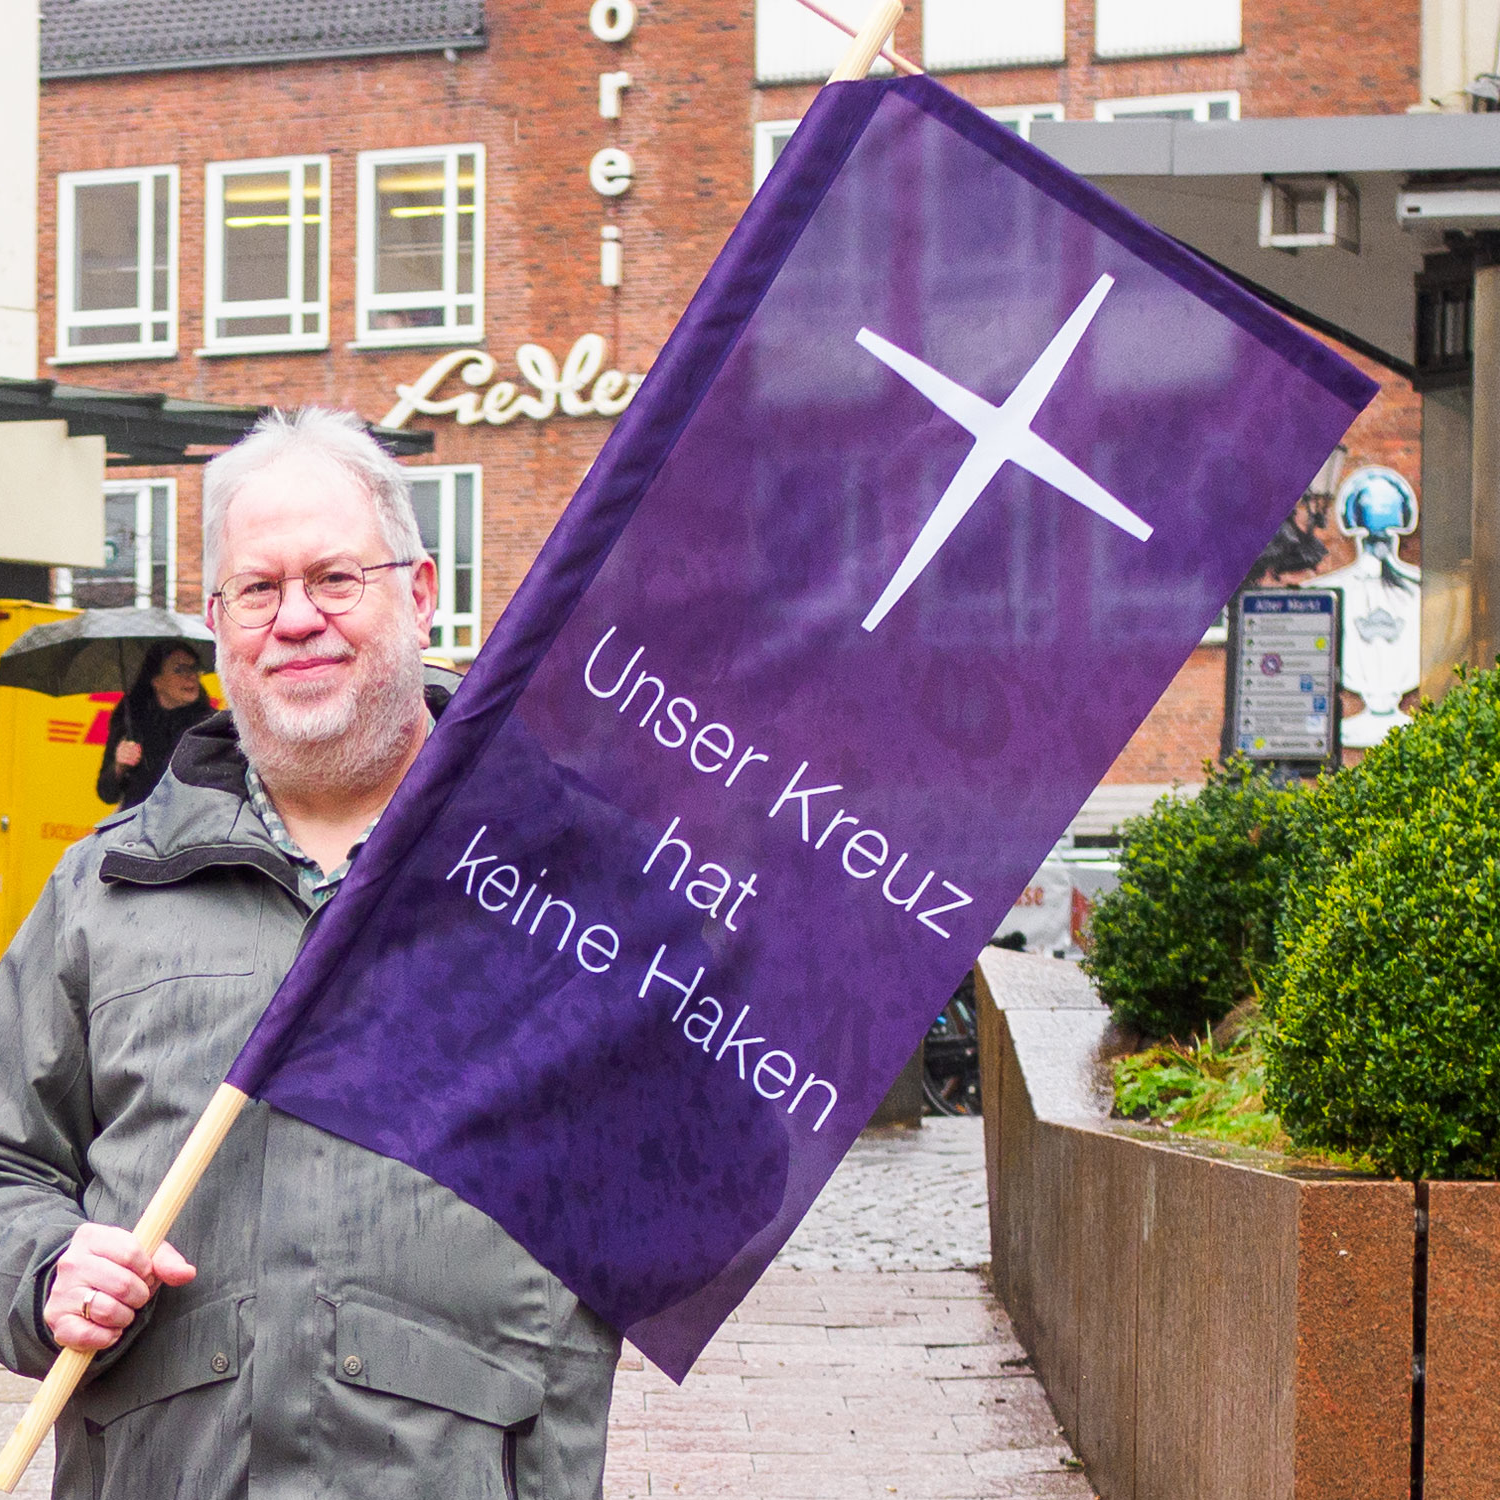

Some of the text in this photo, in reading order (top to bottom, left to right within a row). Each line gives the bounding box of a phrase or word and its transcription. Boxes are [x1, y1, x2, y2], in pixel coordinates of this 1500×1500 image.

[583, 625, 974, 939] Unser Kreuz
[641, 816, 758, 932] hat
[445, 824, 839, 1132] keine Haken
